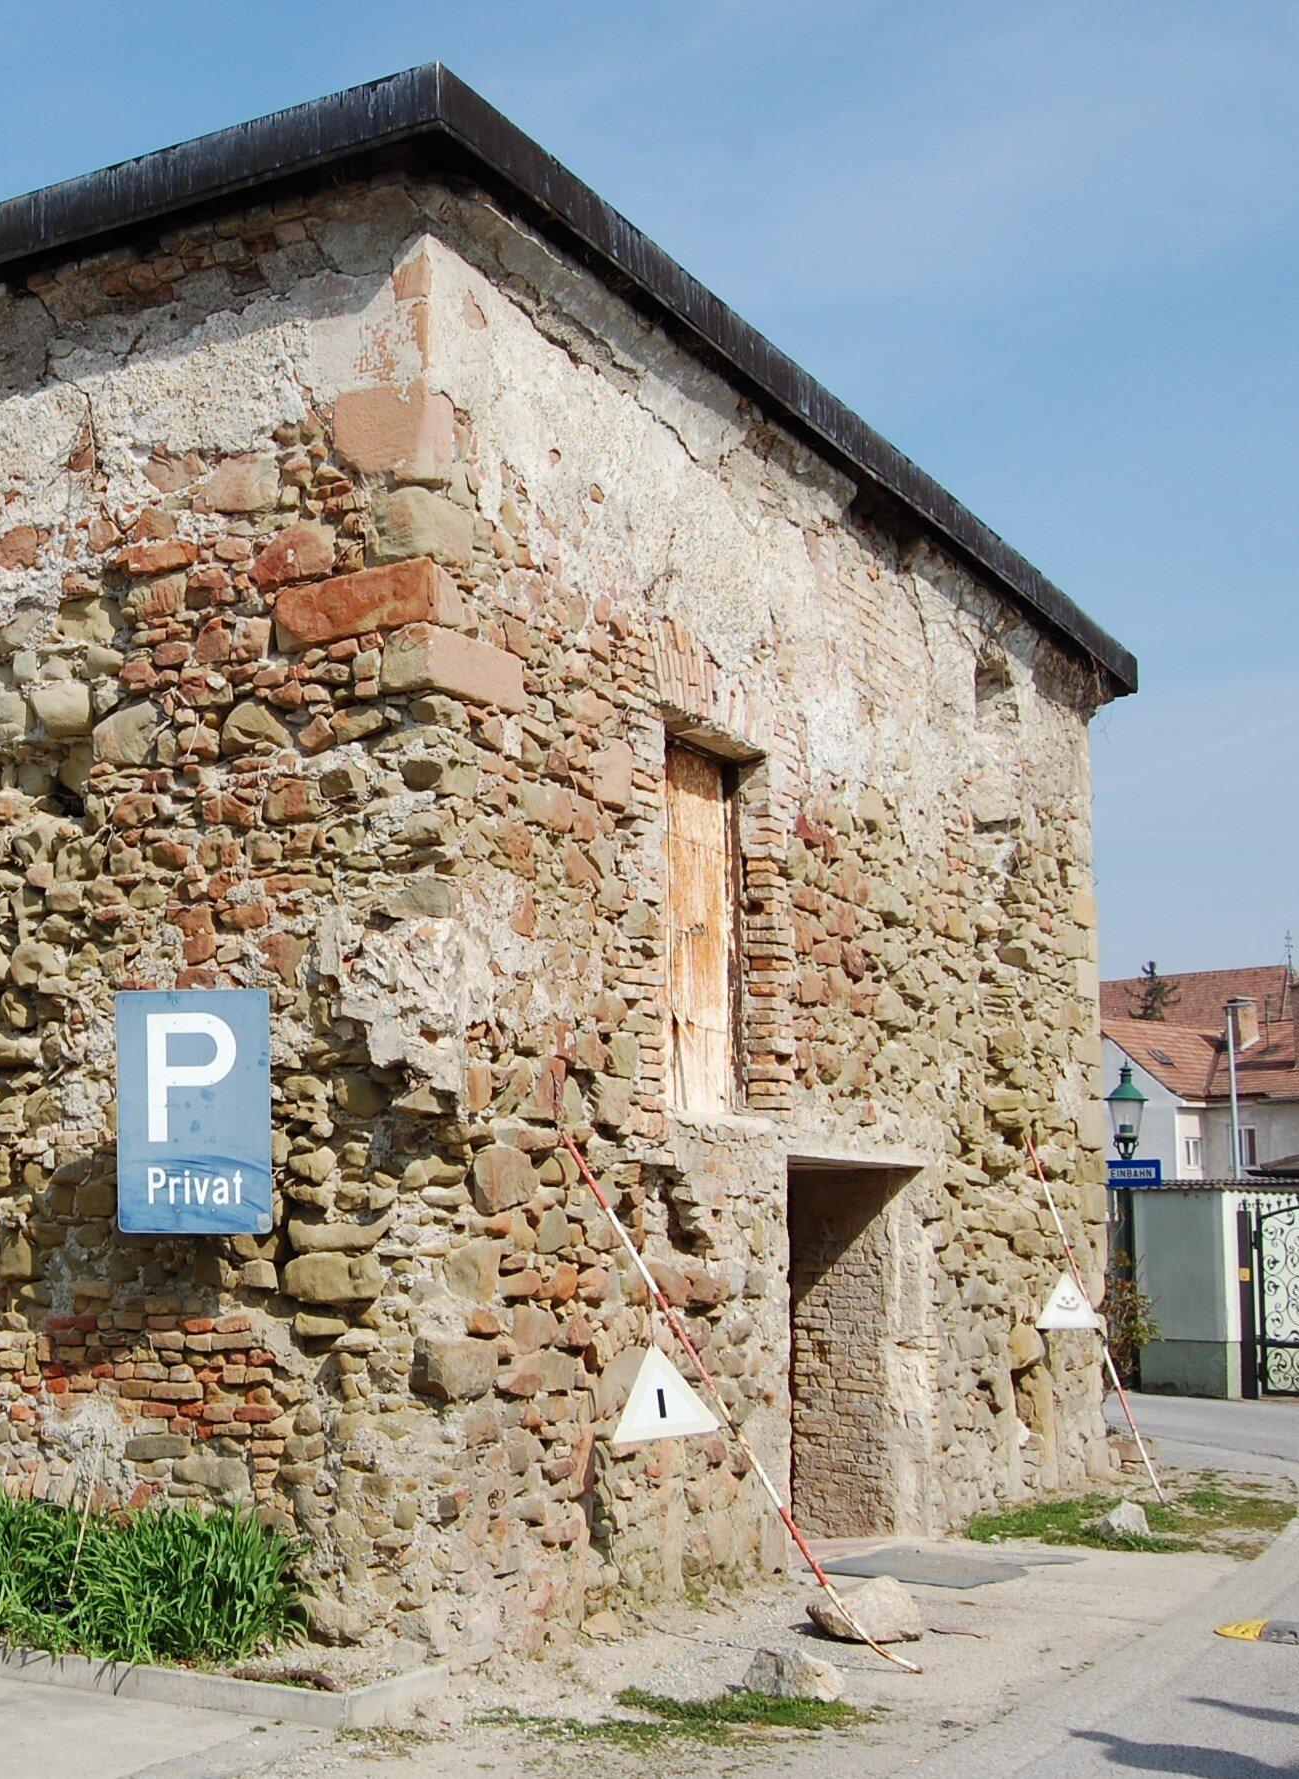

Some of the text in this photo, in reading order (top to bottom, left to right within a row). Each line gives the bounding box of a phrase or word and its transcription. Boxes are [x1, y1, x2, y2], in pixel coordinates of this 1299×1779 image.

[146, 1012, 237, 1143] P
[147, 1166, 243, 1206] Privat
[1110, 1169, 1153, 1178] EINBAHN
